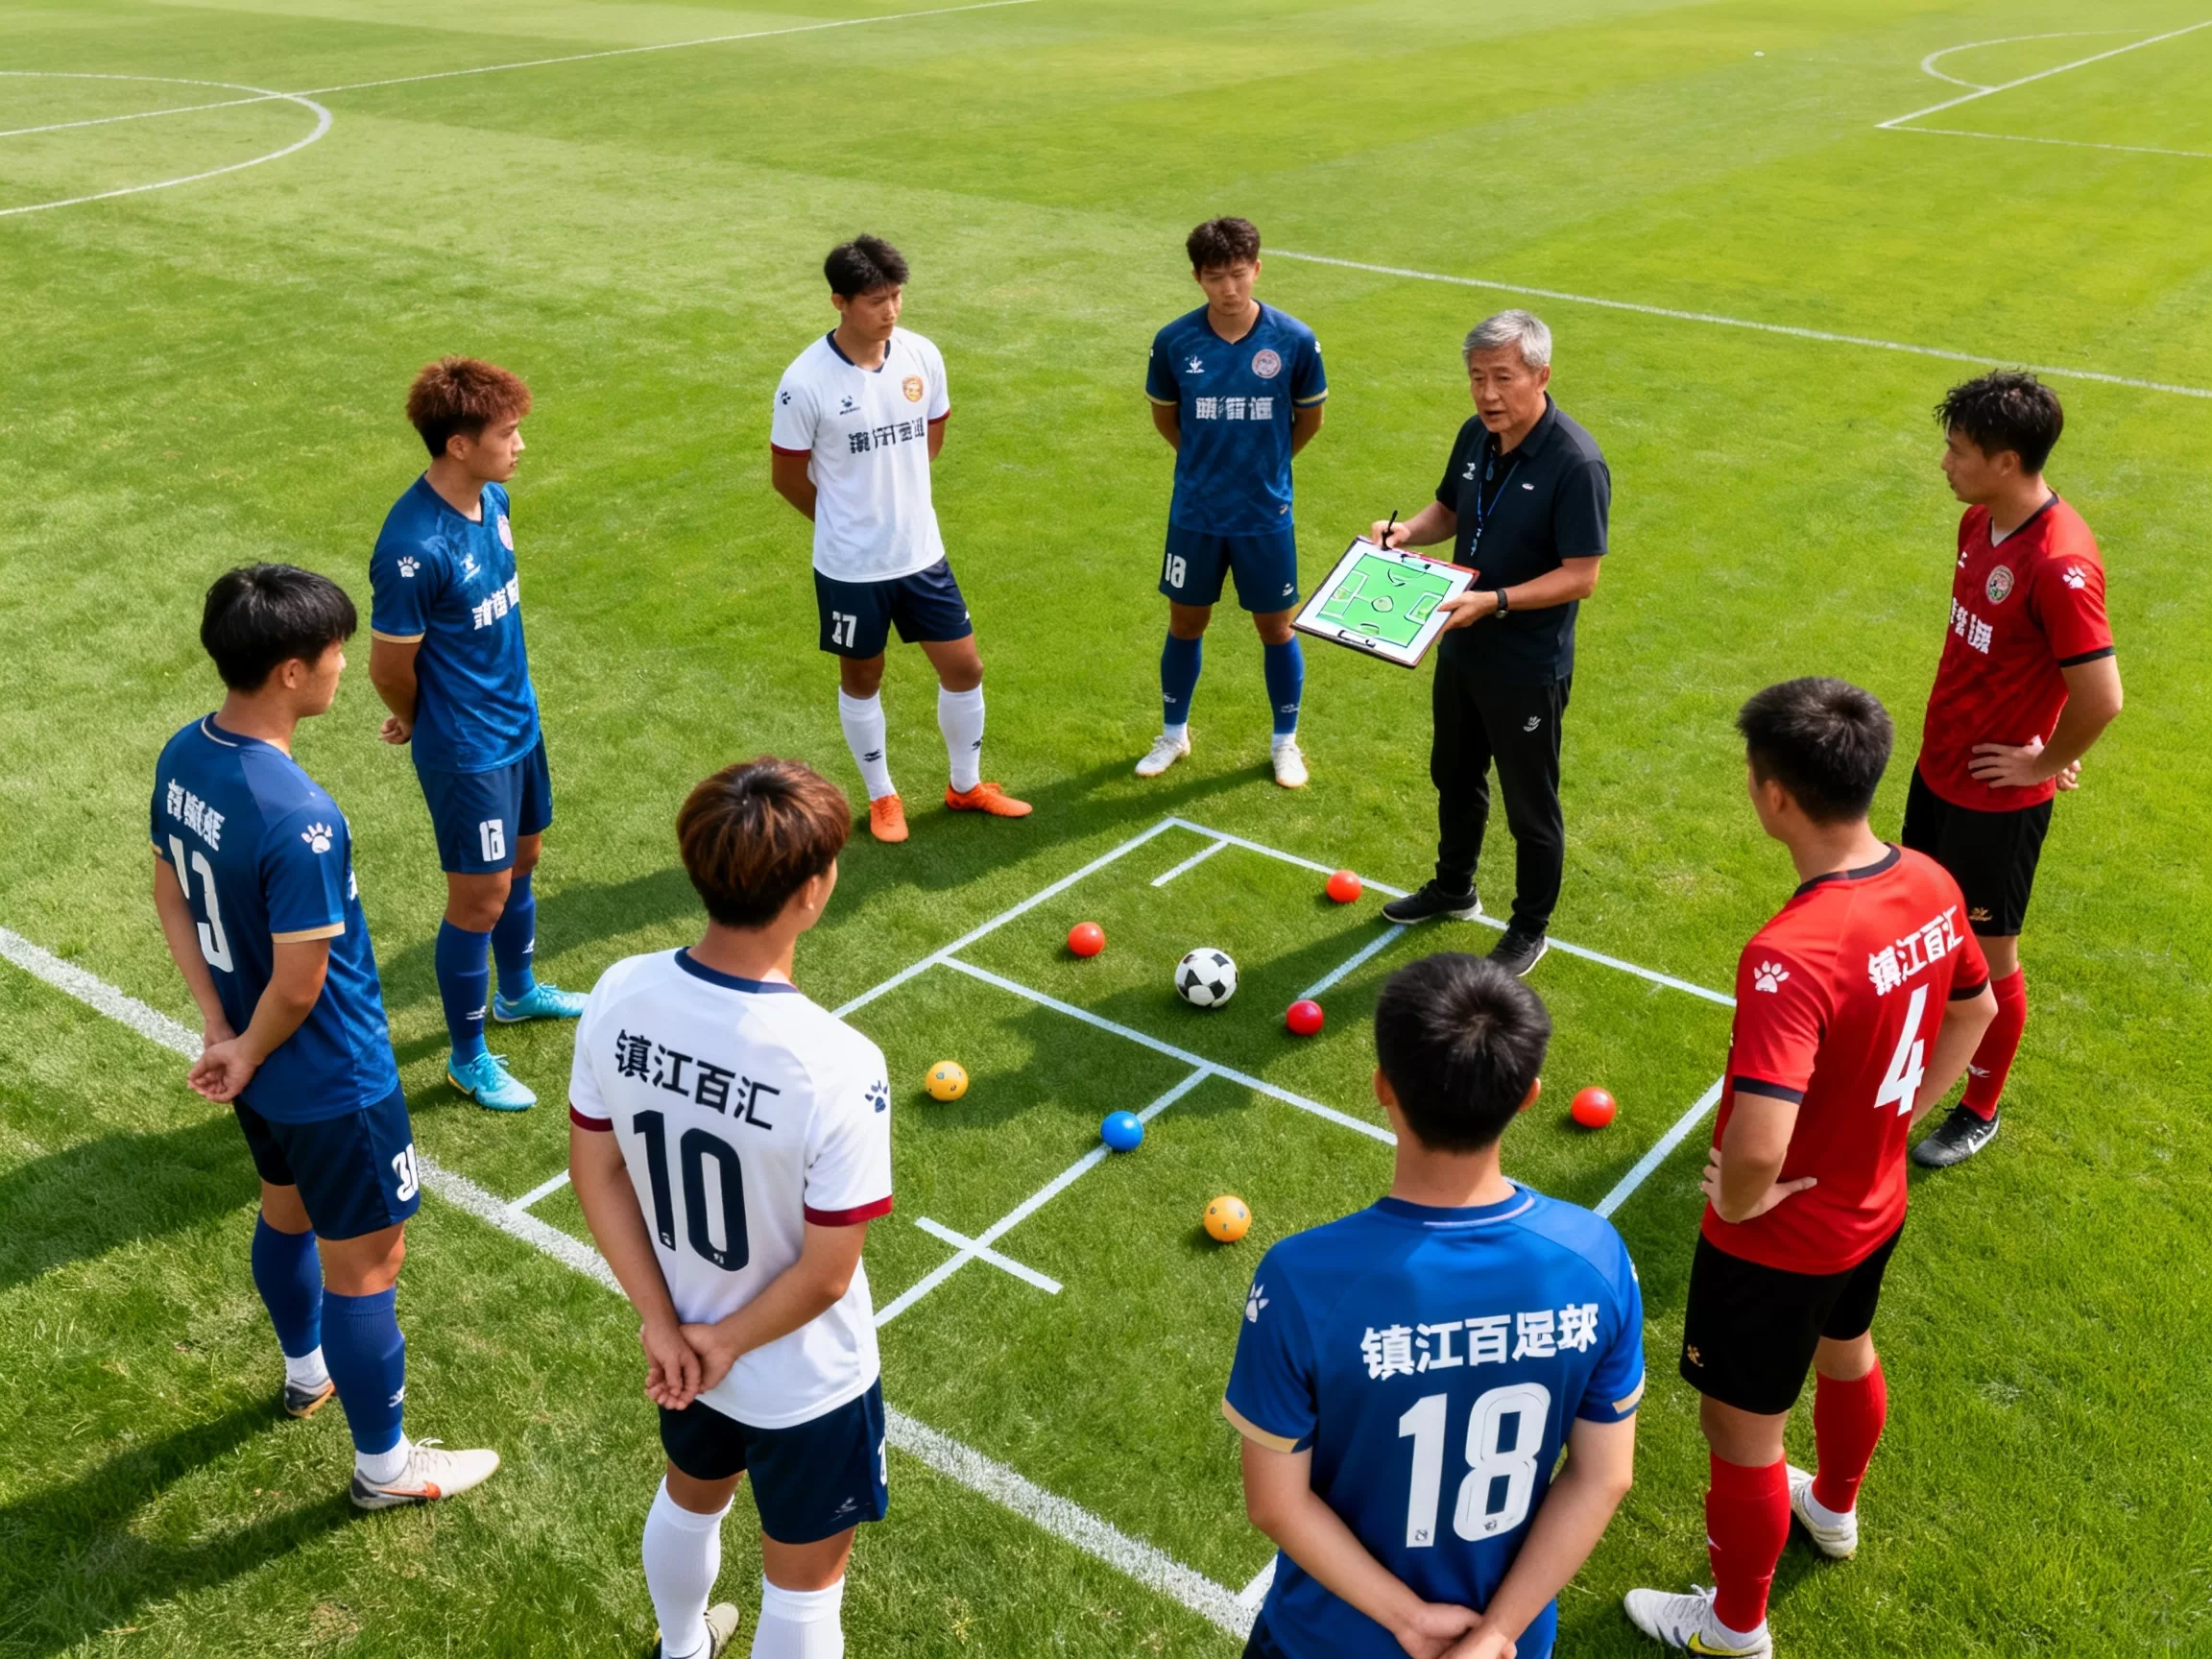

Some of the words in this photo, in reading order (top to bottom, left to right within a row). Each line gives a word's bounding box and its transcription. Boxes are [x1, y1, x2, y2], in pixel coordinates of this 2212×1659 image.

[614, 1029, 781, 1130] 镇江百汇
[1873, 983, 1929, 1117] 4
[633, 1110, 749, 1271] 10
[1399, 1382, 1551, 1548] 18
